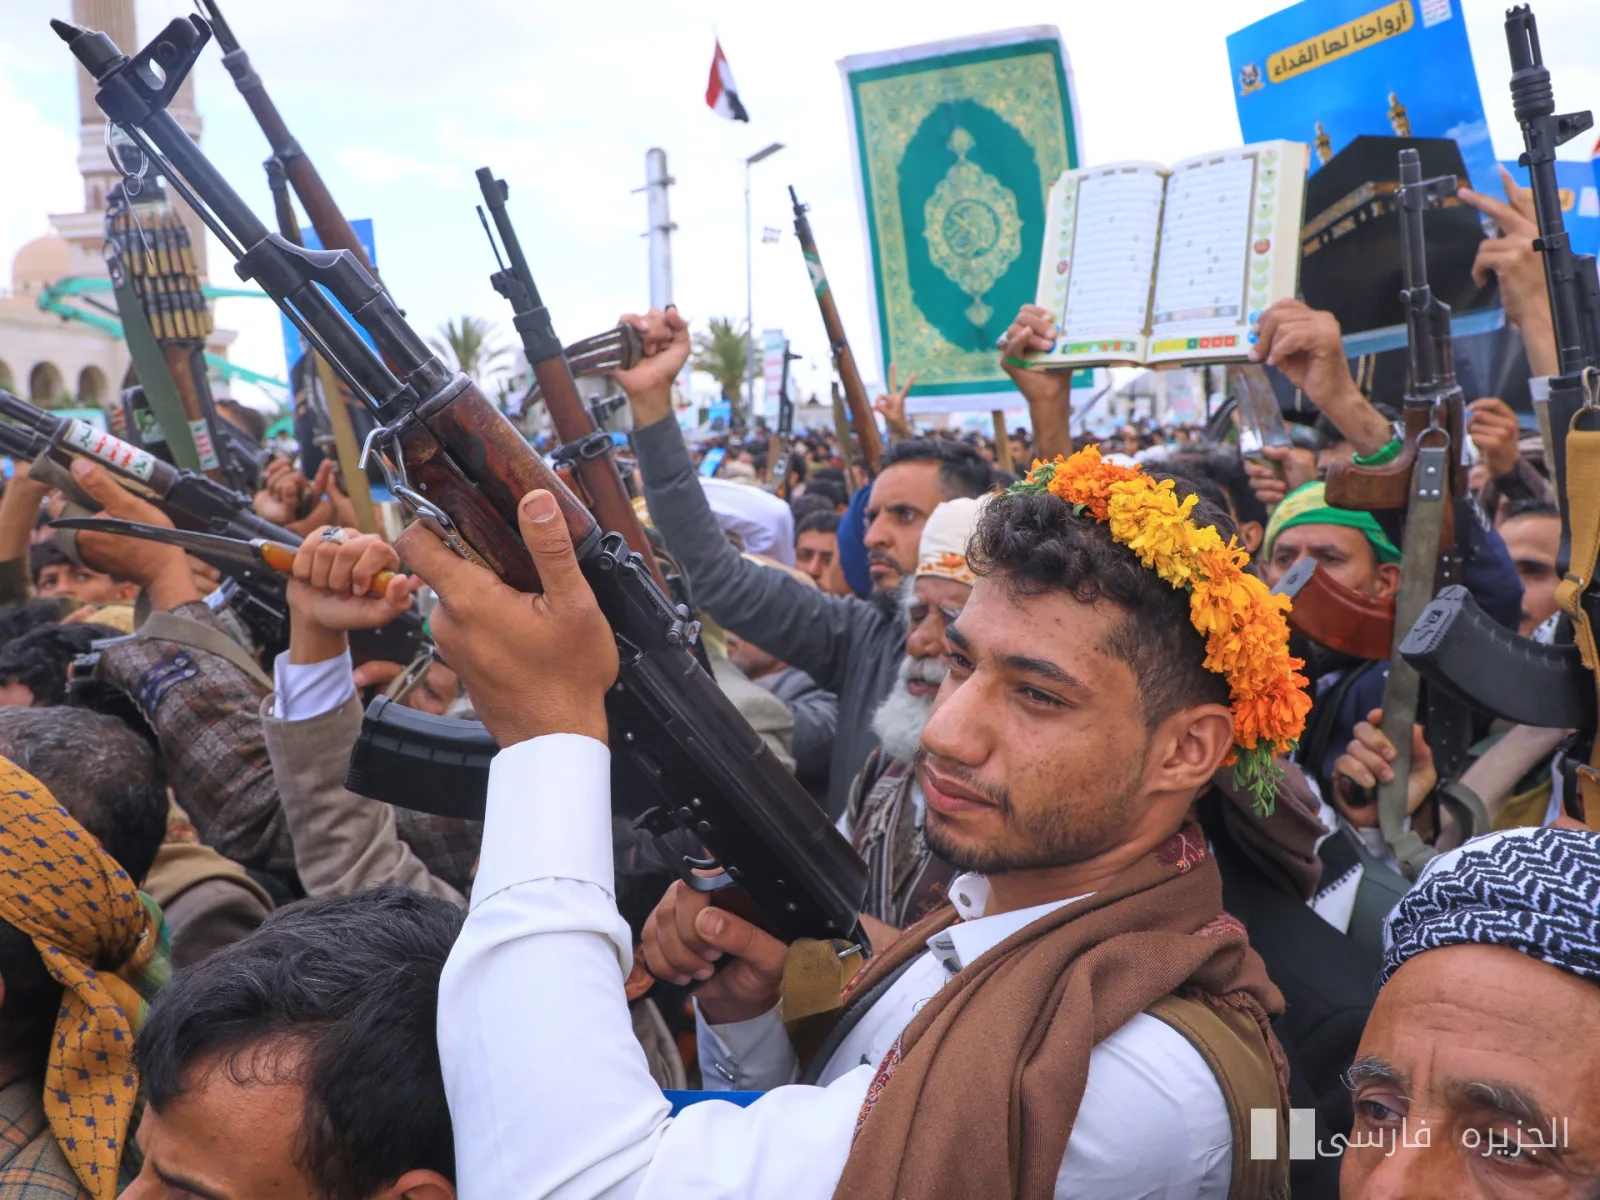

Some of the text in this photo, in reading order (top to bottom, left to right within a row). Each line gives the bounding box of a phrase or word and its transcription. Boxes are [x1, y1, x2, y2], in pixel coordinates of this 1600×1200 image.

[1352, 2, 1407, 43] أرواحنا
[1274, 43, 1319, 76] الفداء
[1322, 31, 1348, 56] لها
